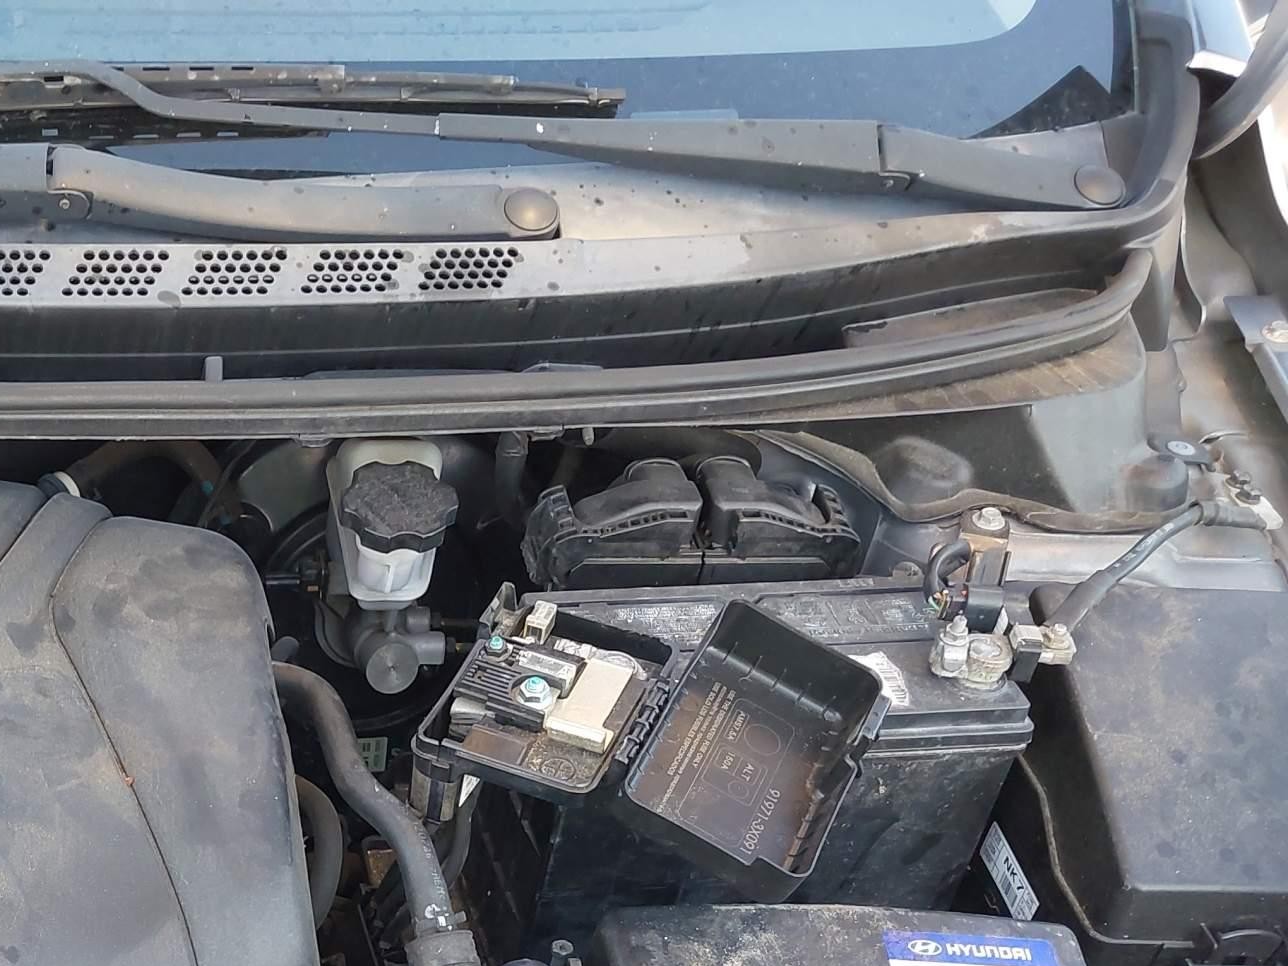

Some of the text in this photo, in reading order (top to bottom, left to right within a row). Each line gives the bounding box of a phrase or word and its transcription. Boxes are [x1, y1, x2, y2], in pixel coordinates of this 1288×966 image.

[738, 762, 756, 782] ALT
[737, 786, 783, 855] 91971-3X091
[1003, 856, 1025, 891] NK7
[945, 943, 1033, 961] HYUNDAI
